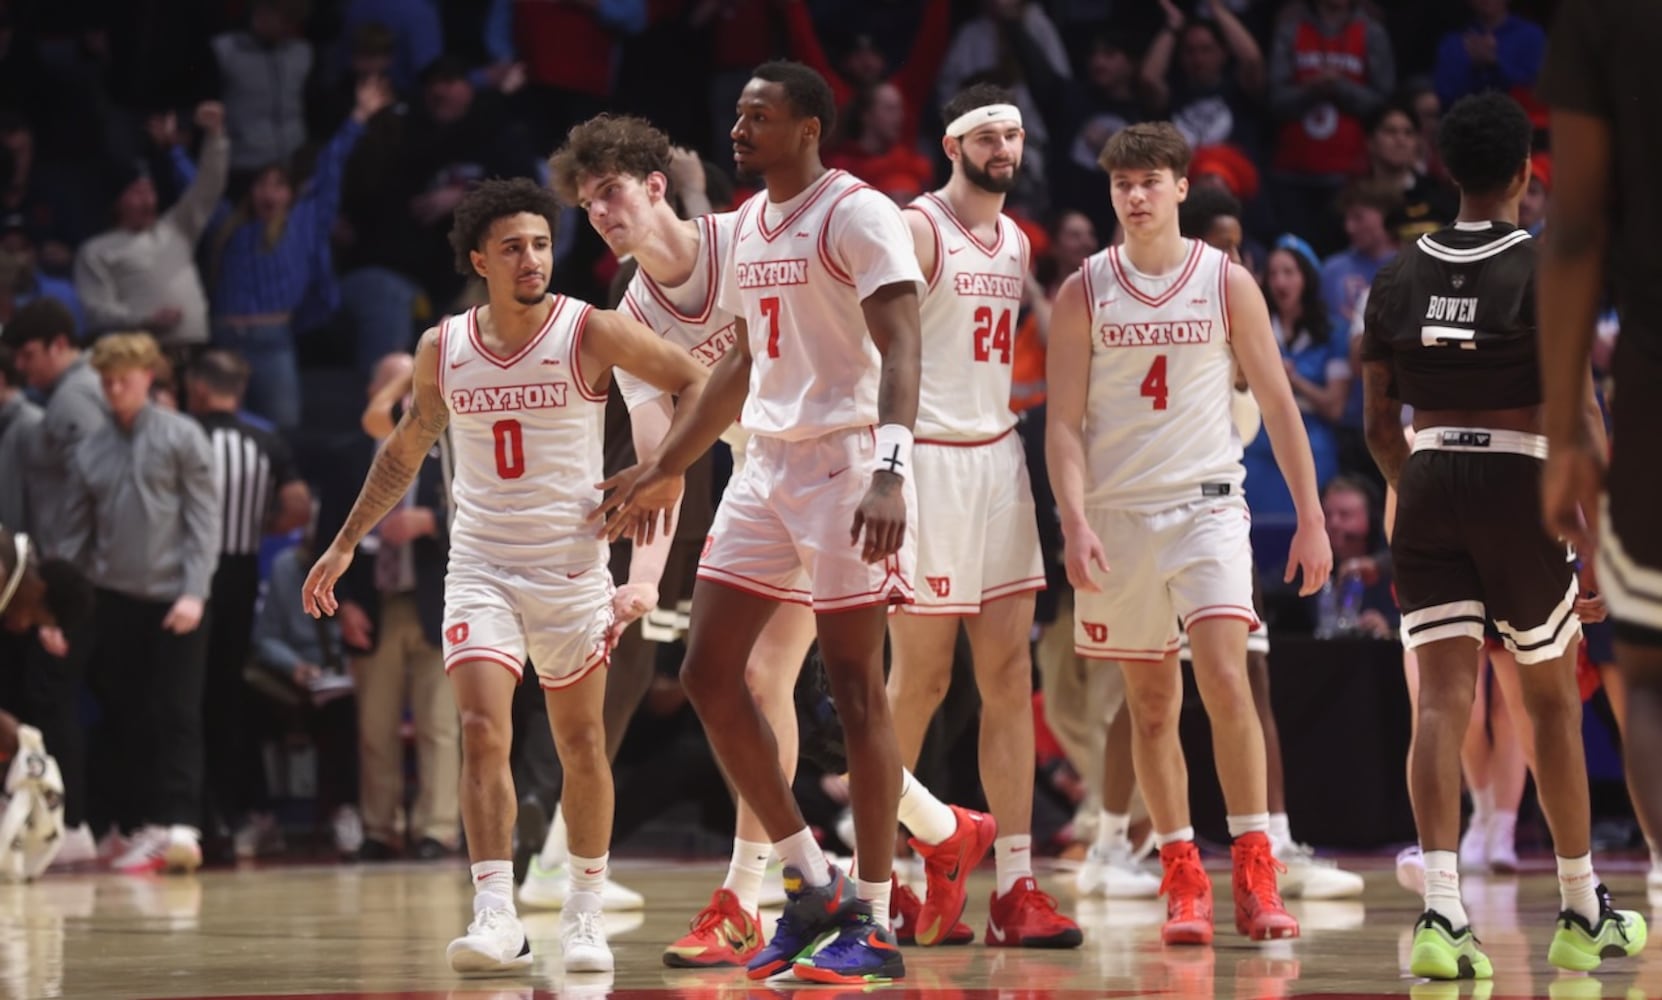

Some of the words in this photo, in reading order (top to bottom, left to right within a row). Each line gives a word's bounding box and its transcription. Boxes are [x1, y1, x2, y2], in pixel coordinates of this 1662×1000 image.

[736, 258, 808, 289] DAYTON
[954, 272, 1022, 300] DAYTON
[1425, 295, 1479, 323] BOWEN
[759, 297, 780, 358] 7
[974, 306, 1011, 364] 24
[1101, 320, 1212, 348] DAYTON
[451, 382, 567, 415] DAYTON
[1140, 355, 1168, 410] 4
[492, 419, 525, 479] 0
